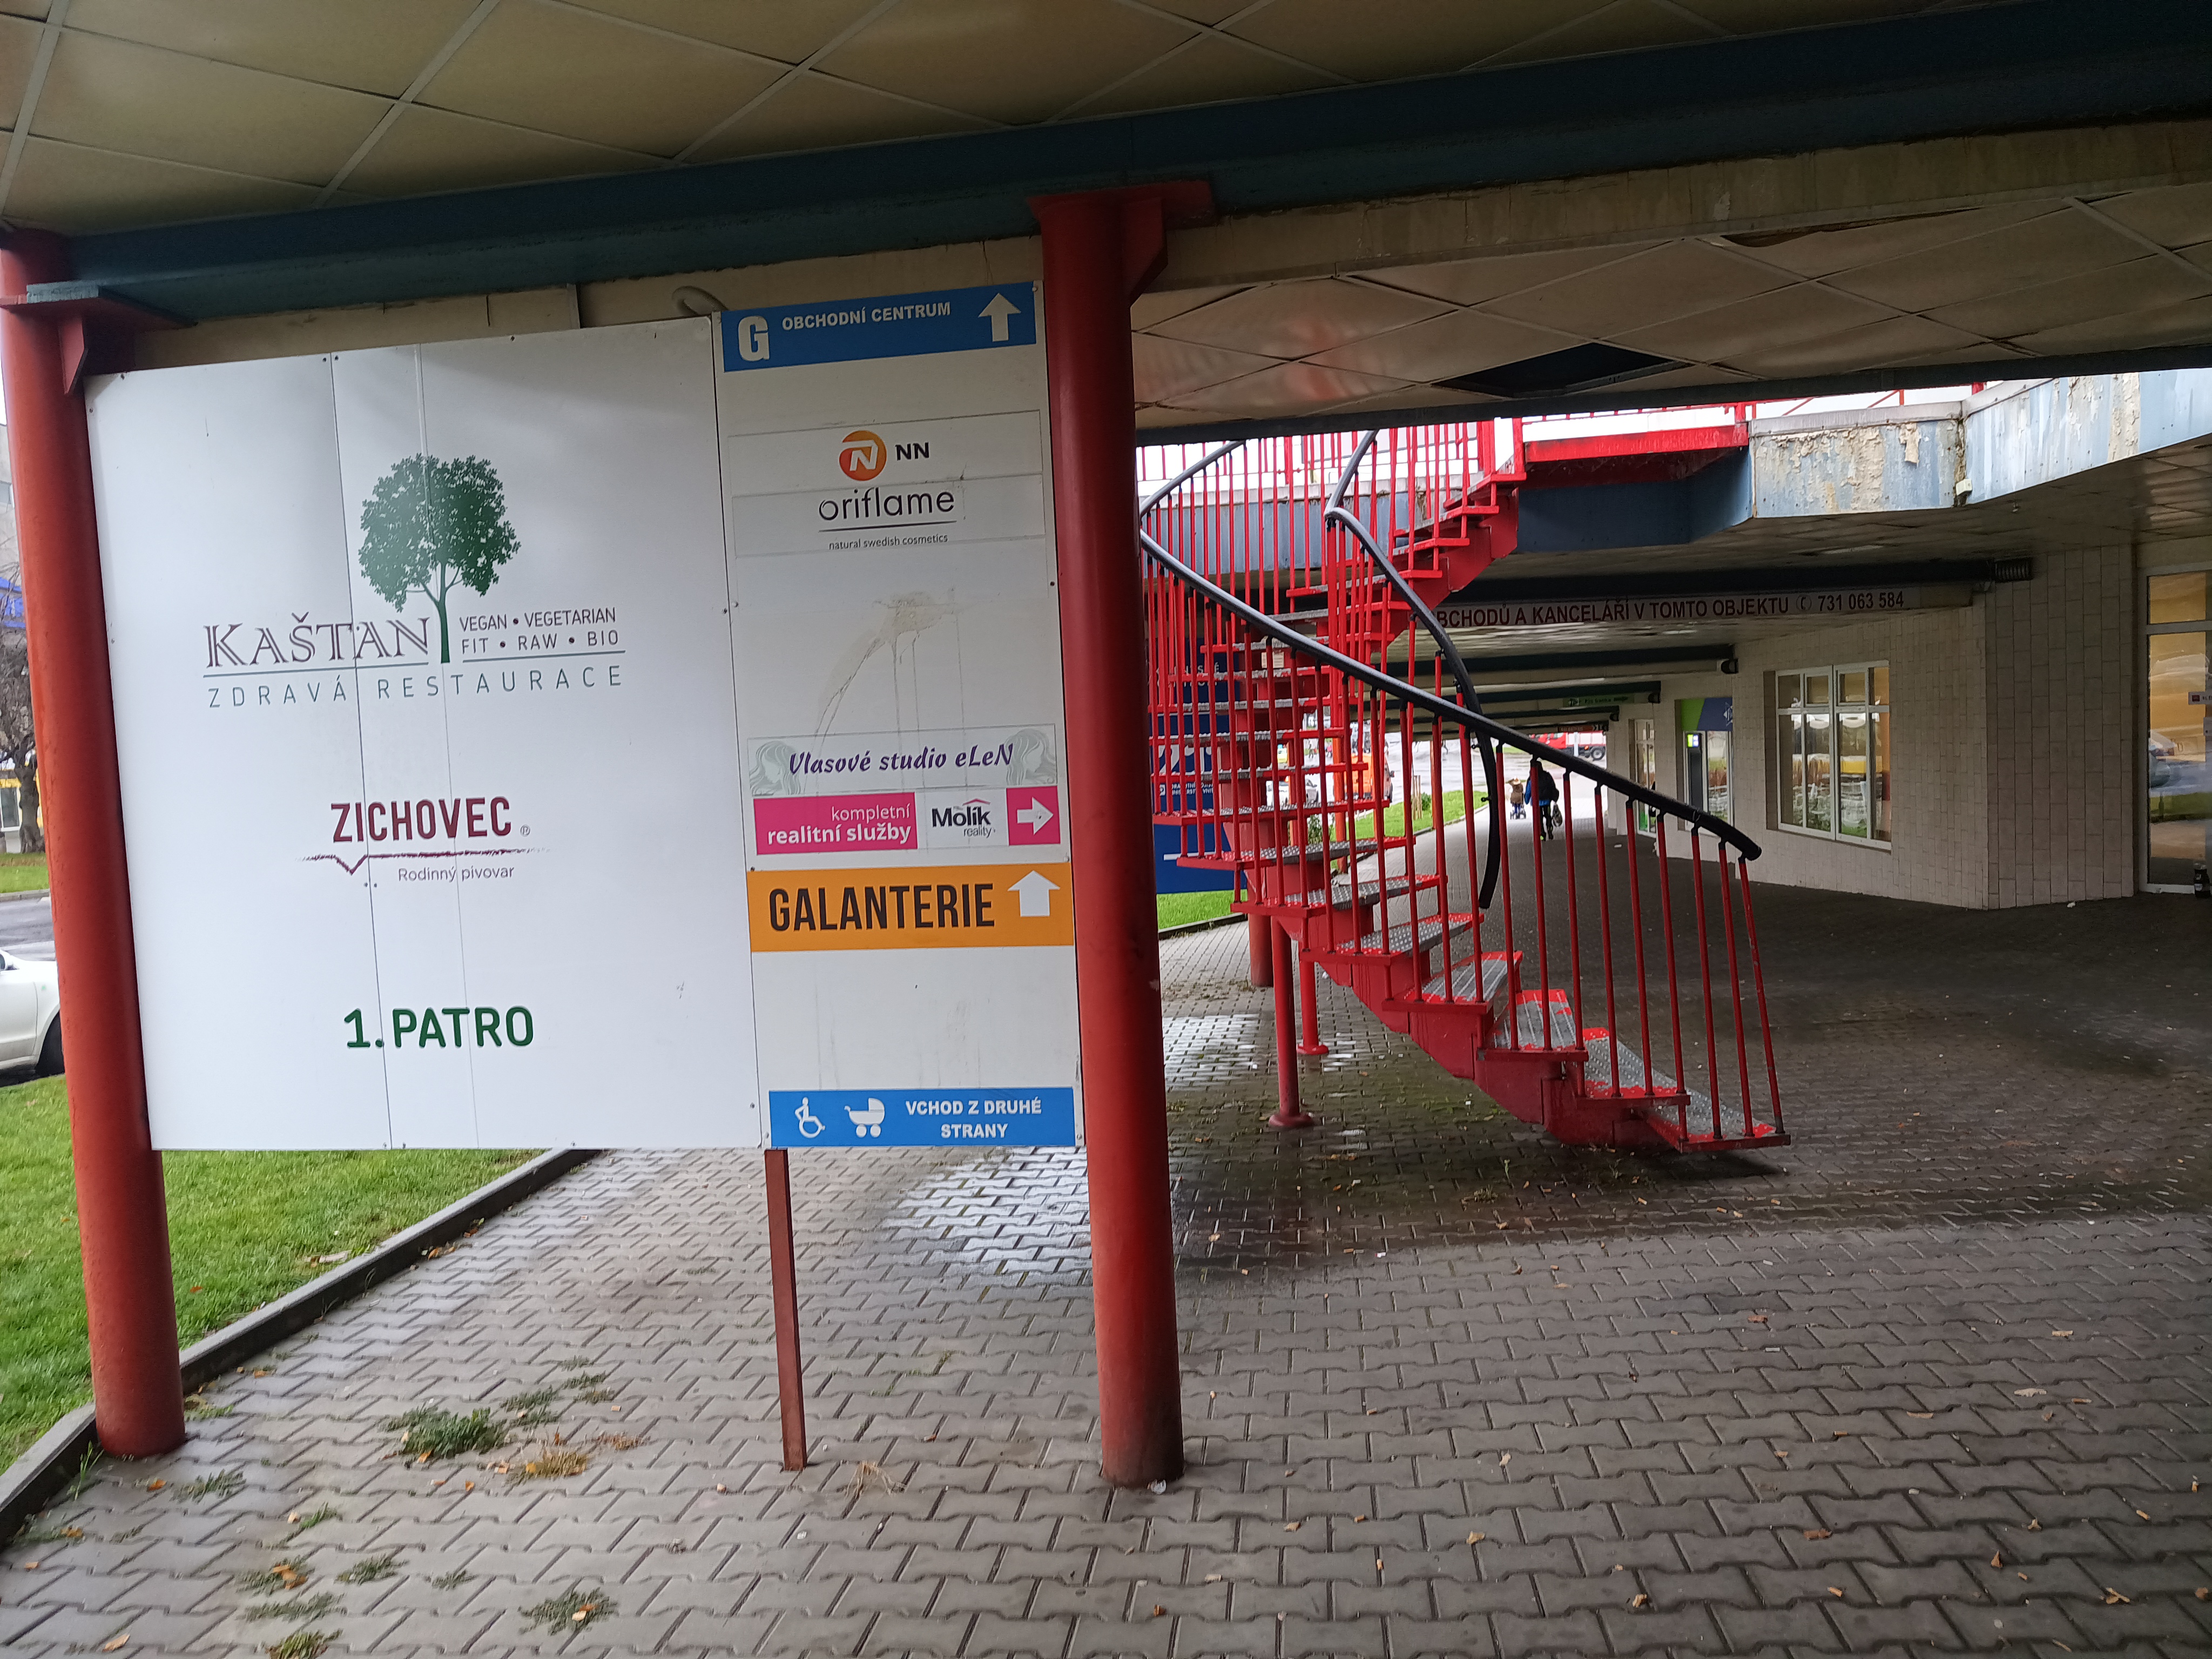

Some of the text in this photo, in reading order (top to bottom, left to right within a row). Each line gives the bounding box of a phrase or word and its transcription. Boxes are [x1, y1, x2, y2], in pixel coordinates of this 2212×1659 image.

[783, 301, 951, 331] OBCHODNÍ CENTRUM
[738, 315, 770, 361] G
[894, 441, 930, 461] NN
[819, 487, 955, 521] oriflame
[829, 534, 948, 550] natural swedish cosmetics
[459, 606, 617, 632] VEGAN VEGETARIAN
[1432, 590, 1905, 628] BCHODŮ A KANCELÁŘÍ V TOMTO OBJEKTU 731 063 584
[203, 611, 431, 669] KAŠTAN
[462, 630, 619, 655] FIT RAW BIO
[208, 665, 622, 709] ZDRAVÁ RESTAURACE
[790, 743, 1014, 775] Vlasové studio eLeN
[331, 796, 512, 843] ZICHOVEC
[831, 802, 912, 823] kompletní
[932, 805, 992, 828] Molík
[768, 821, 912, 845] realitní služby
[963, 825, 993, 839] reality
[398, 865, 515, 883] Rodinný pivovar
[769, 882, 996, 933] GALANTERIE
[906, 1096, 1042, 1116] VCHOD Z DRUHÉ
[940, 1123, 1008, 1138] STRANY
